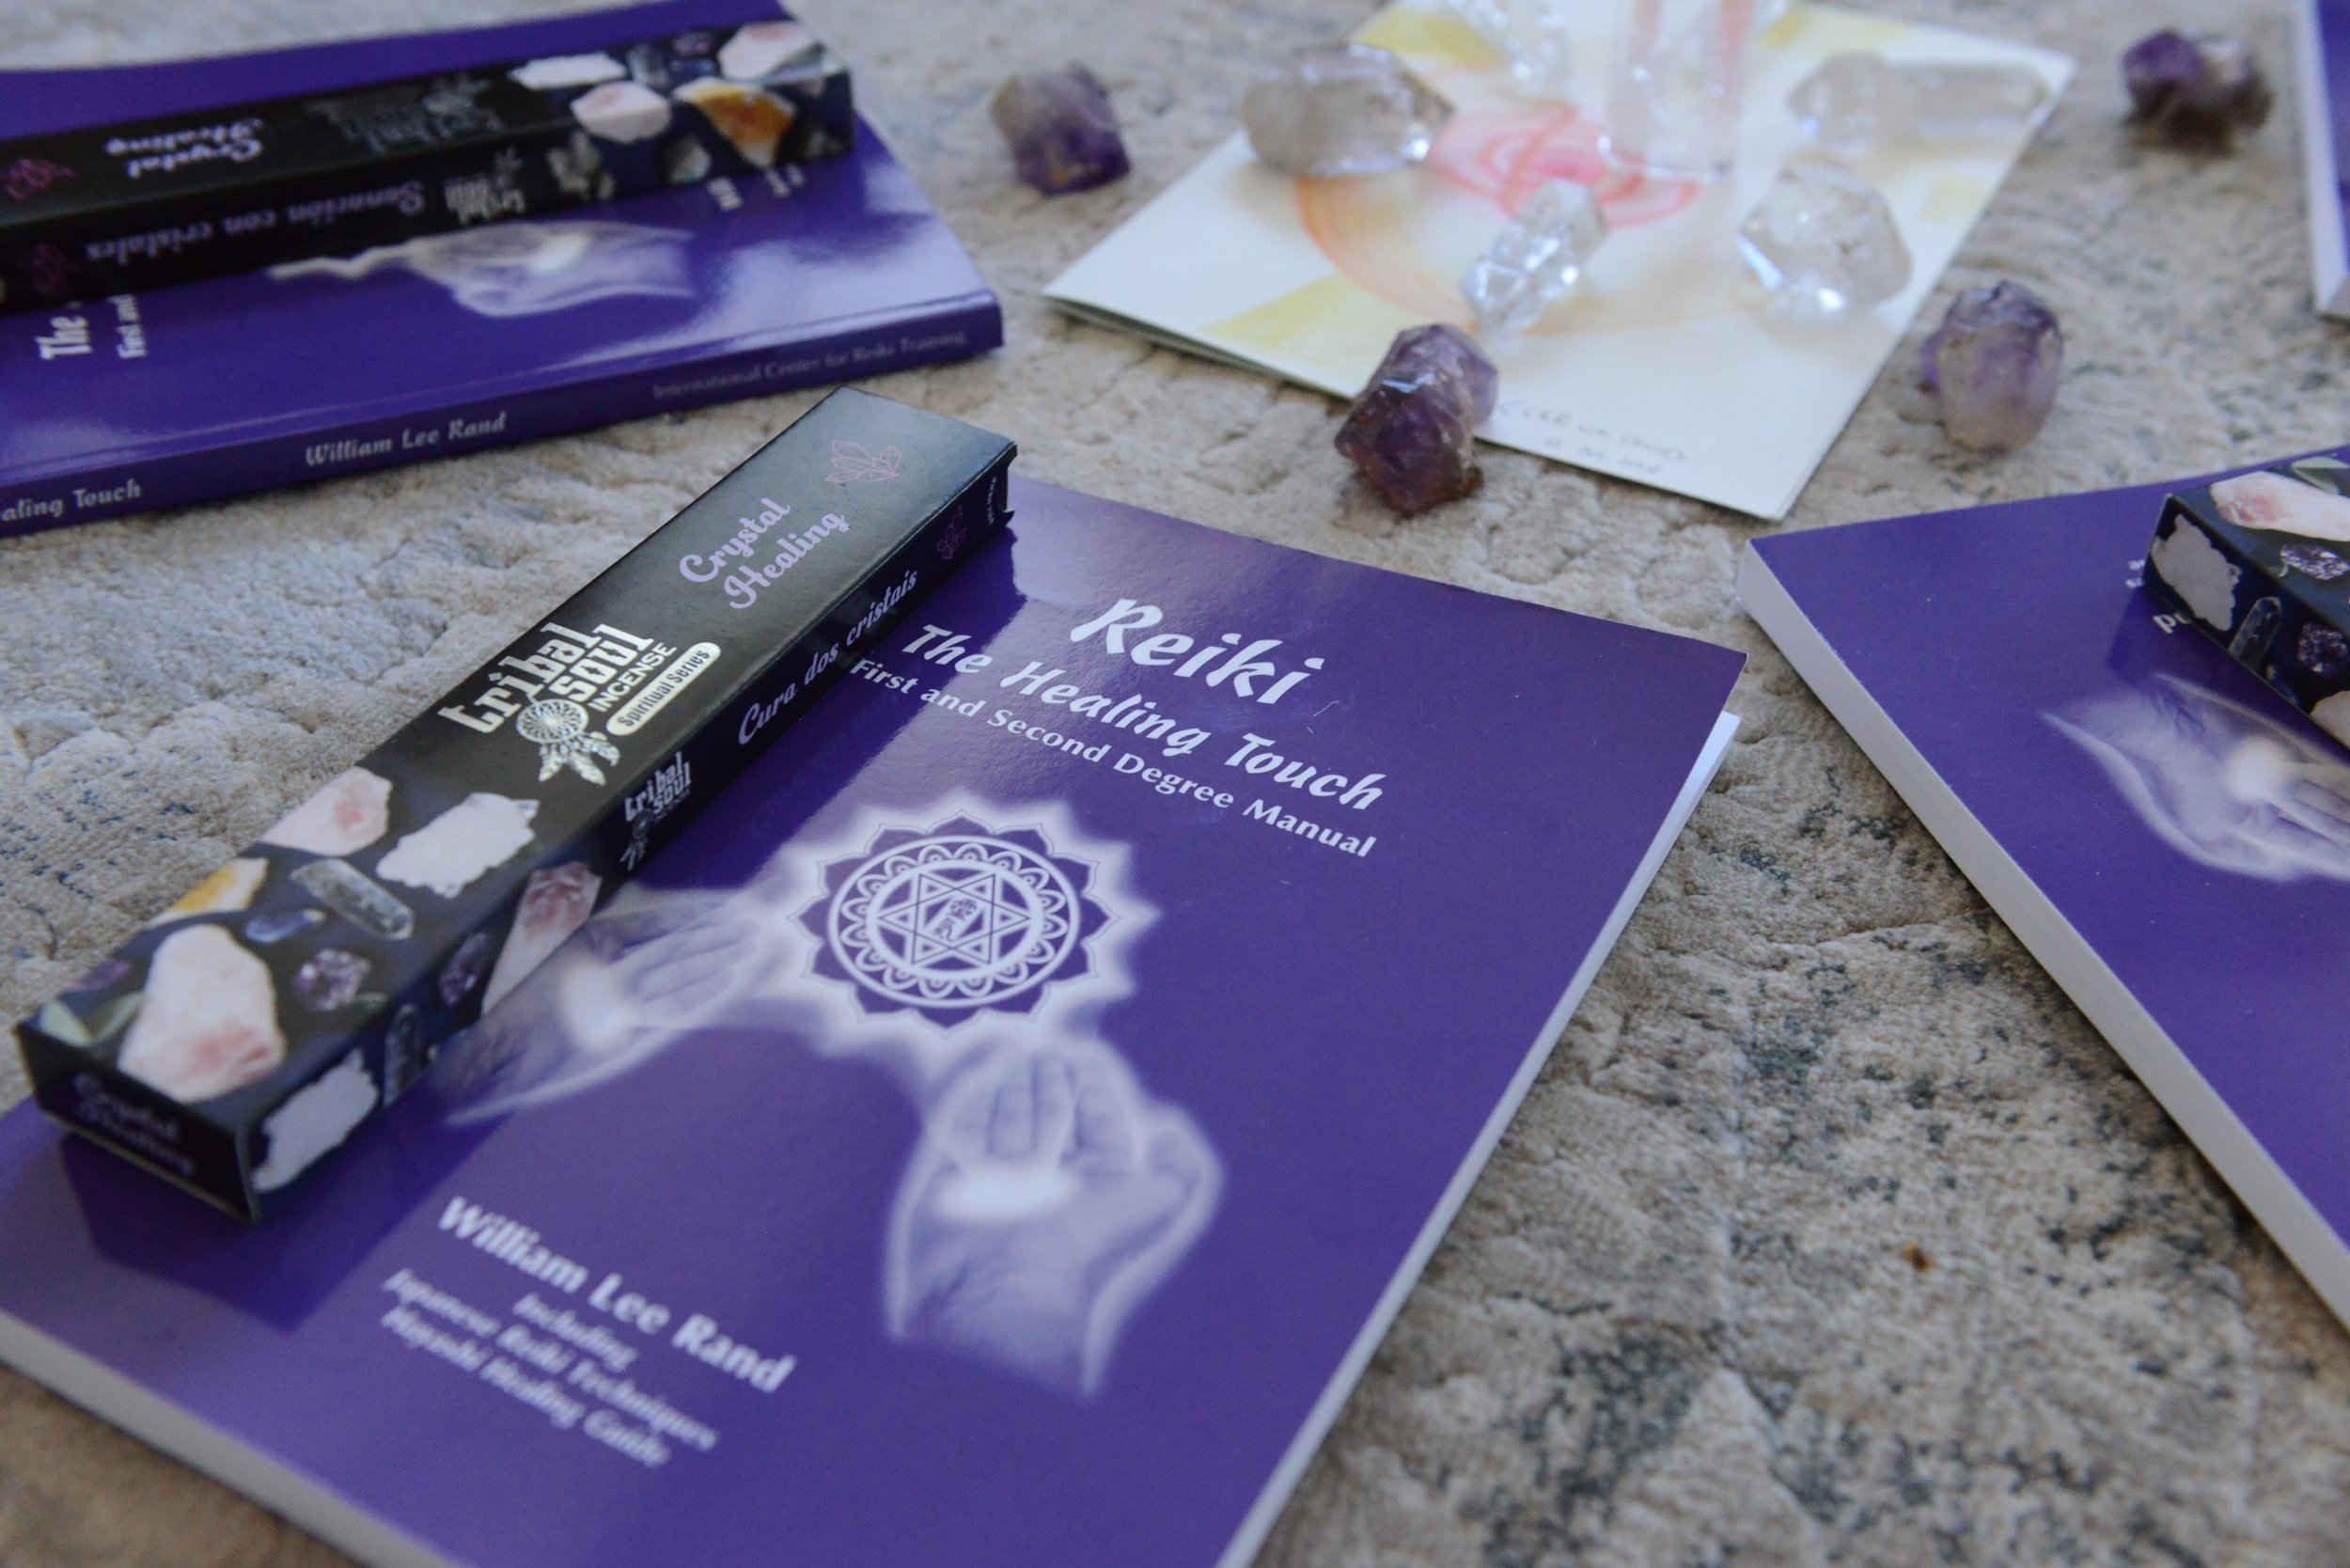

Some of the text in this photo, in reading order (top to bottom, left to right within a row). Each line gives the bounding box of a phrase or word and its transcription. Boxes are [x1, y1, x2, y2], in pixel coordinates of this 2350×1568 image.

[86, 219, 214, 266] cristales
[222, 207, 278, 235] con
[35, 314, 92, 359] The
[306, 410, 507, 466] William Lee Rand
[72, 478, 141, 509] Touch
[679, 497, 791, 583] Crystal
[724, 512, 851, 609] Healing
[437, 622, 603, 733] tribal
[549, 623, 655, 703] soul
[588, 642, 677, 713] INCENSE
[617, 649, 711, 728] Spiritual Series
[738, 570, 918, 745] Cura dos cristais
[1070, 598, 1325, 705] Reiki
[850, 657, 1378, 859] First and Second Degree Manual
[901, 624, 1386, 811] The Healing Touch
[438, 1196, 797, 1393] William Lee Rand
